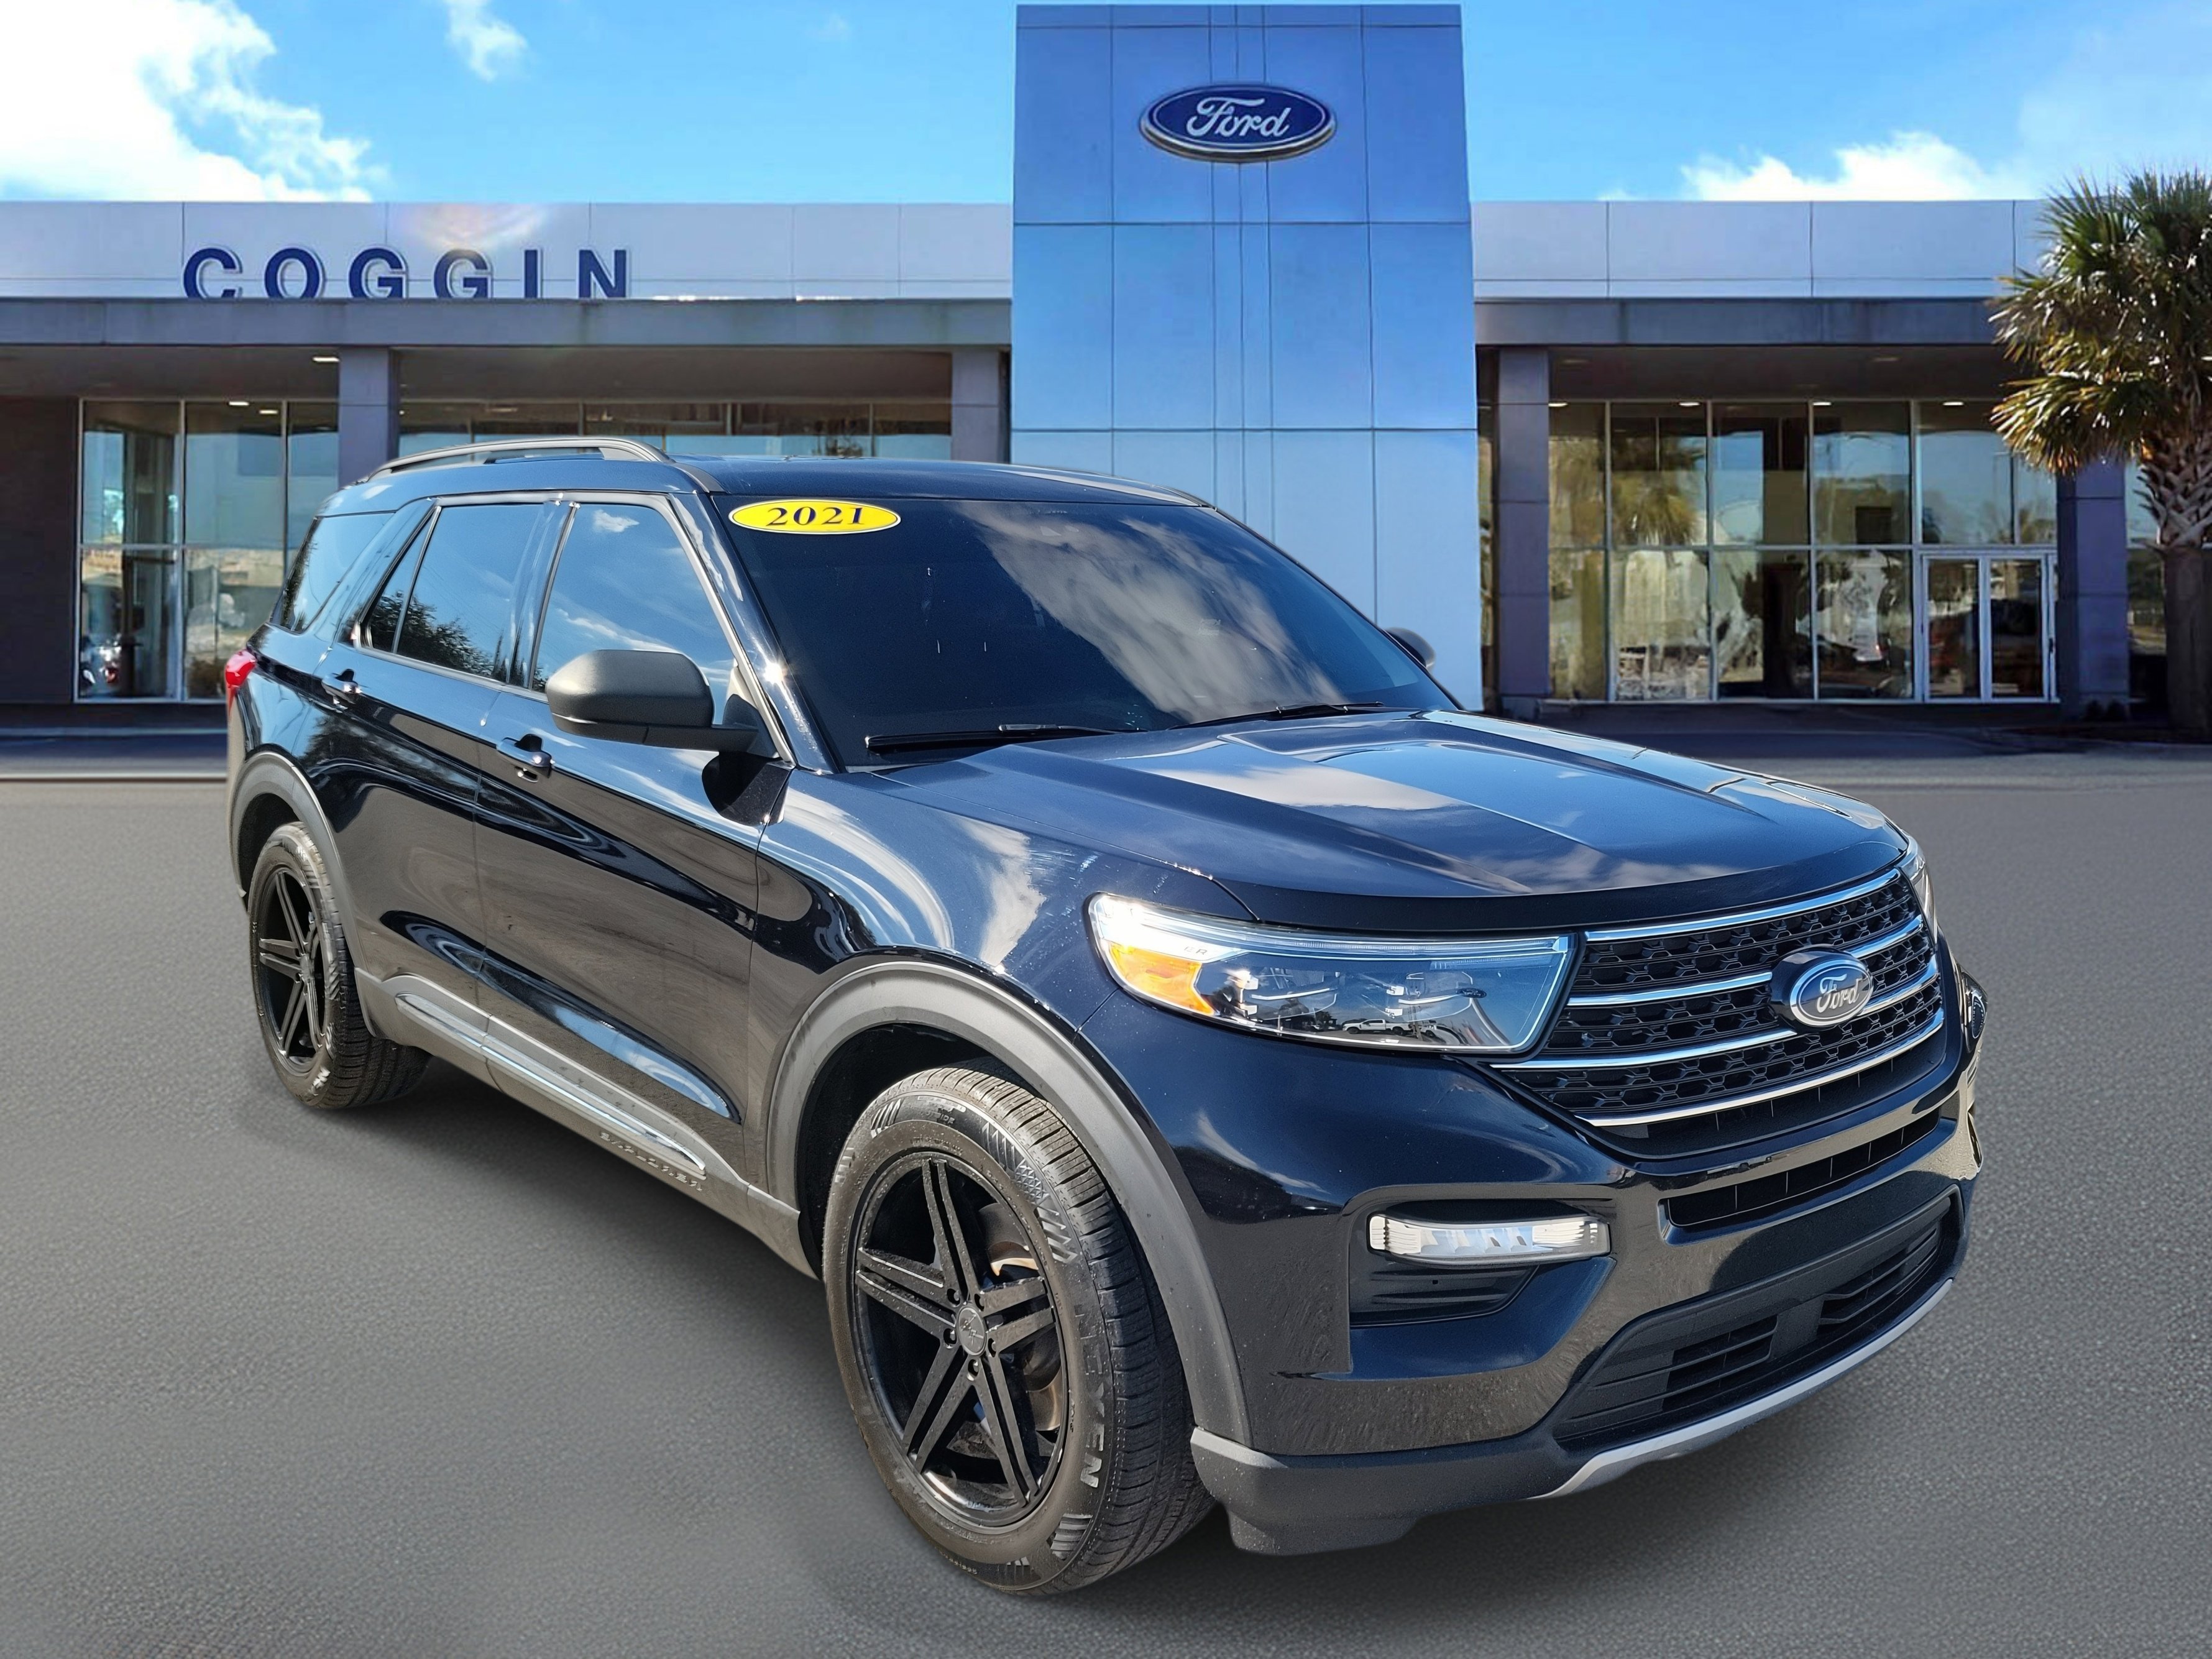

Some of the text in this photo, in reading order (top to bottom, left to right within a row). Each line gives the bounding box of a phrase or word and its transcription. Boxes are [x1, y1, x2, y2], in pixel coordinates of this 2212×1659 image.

[1186, 96, 1292, 137] Ford
[183, 247, 628, 299] COGGIN
[765, 506, 865, 526] 2021
[1817, 973, 1863, 1013] Ford
